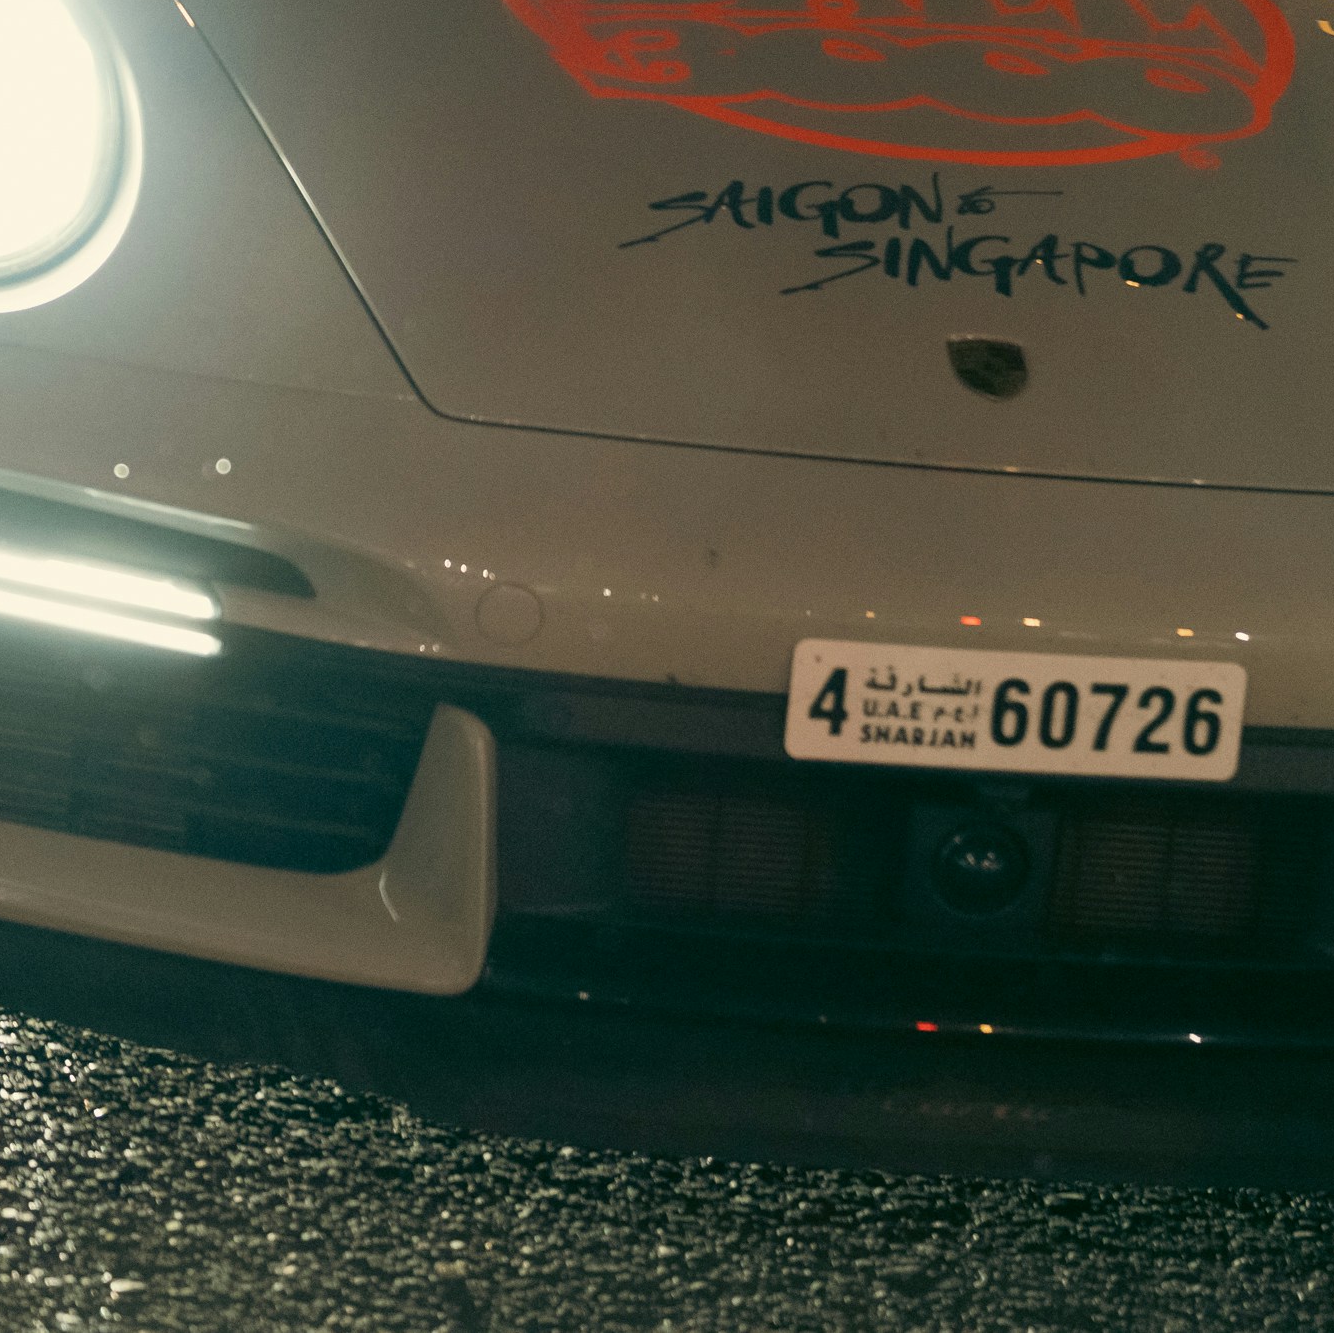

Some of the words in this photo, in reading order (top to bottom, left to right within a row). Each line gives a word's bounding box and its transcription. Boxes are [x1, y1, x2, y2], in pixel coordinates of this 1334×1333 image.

[618, 171, 944, 249] SAIGON
[780, 226, 1299, 330] SINGAPORE
[808, 667, 849, 736] 4
[859, 723, 976, 750] SHARJAH
[991, 677, 1224, 756] 60726
